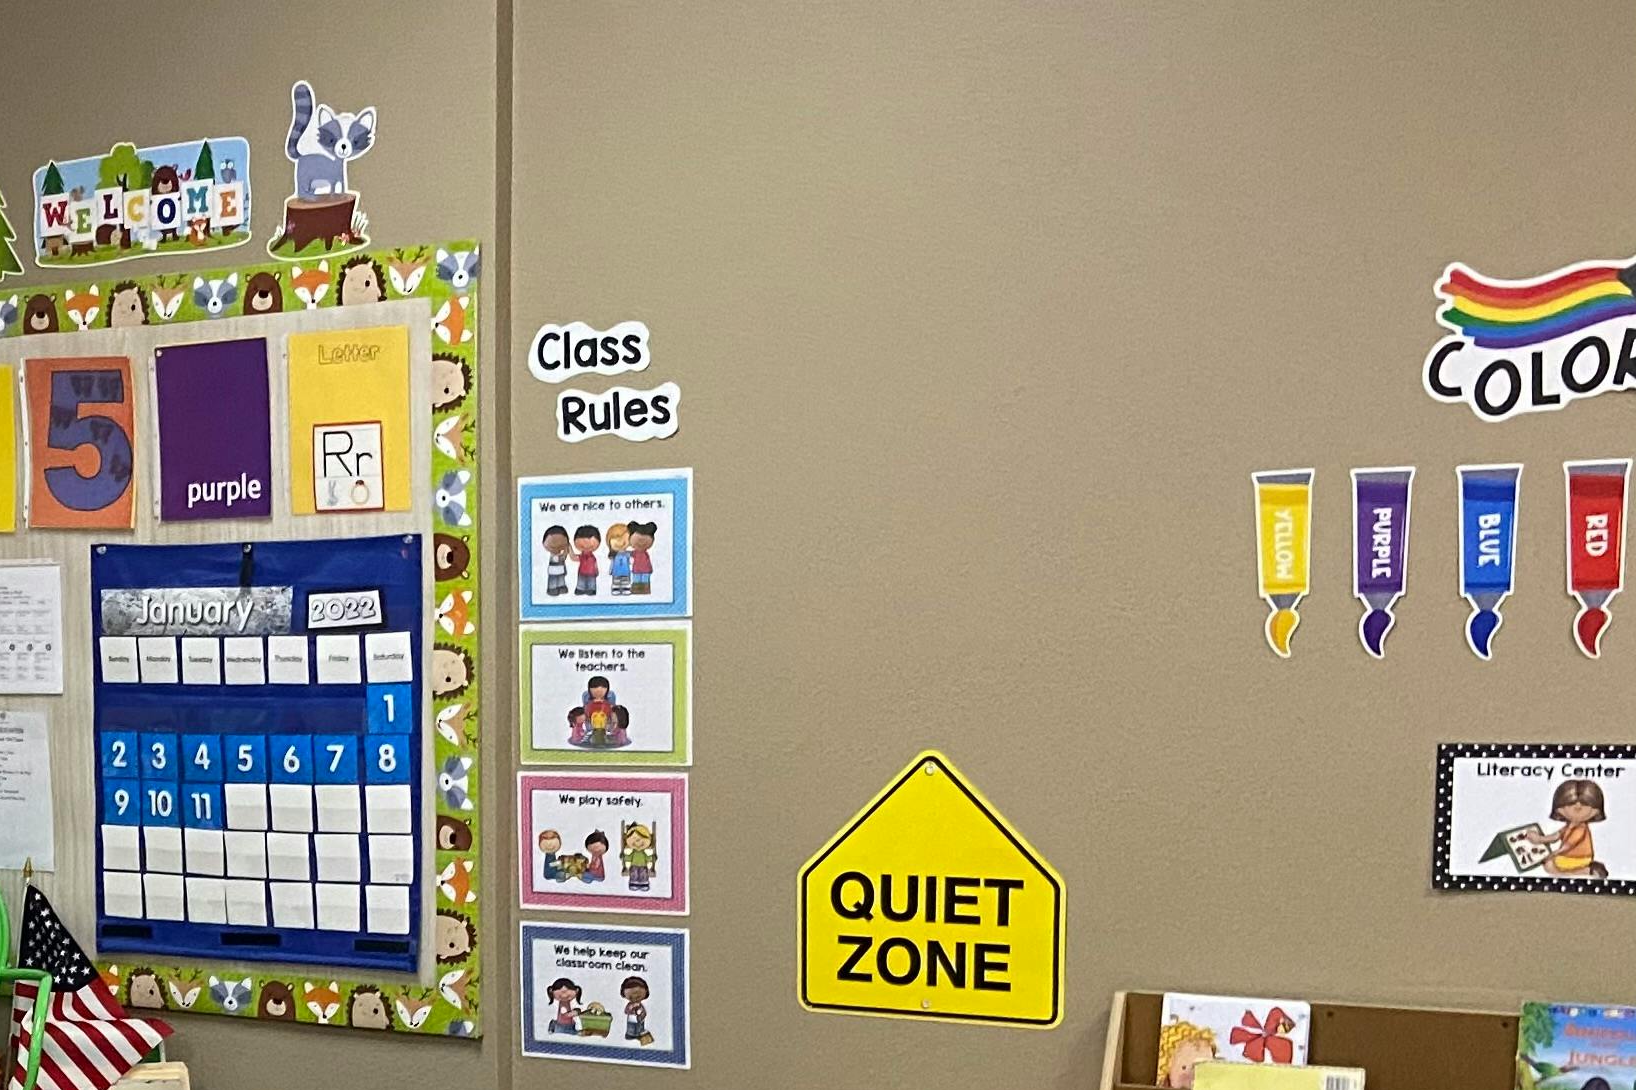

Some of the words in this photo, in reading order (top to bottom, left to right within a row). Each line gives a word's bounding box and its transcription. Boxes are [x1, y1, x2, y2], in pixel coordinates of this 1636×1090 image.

[43, 185, 237, 234] WELCOME
[318, 343, 380, 366] Letter
[537, 331, 642, 370] Class
[561, 391, 670, 435] Rules
[44, 370, 133, 511] 5
[323, 430, 373, 478] Rr
[188, 473, 261, 508] purple
[539, 501, 557, 513] We
[563, 502, 580, 512] are
[582, 500, 606, 511] nice
[610, 500, 621, 510] to
[625, 499, 665, 510] others.
[1274, 509, 1295, 581] YELLOW
[1371, 507, 1393, 579] PURPLE
[1478, 513, 1501, 567] BLUE
[1585, 513, 1609, 557] RED
[136, 595, 253, 632] January
[311, 598, 376, 622] 2022
[558, 648, 575, 660] We
[578, 648, 608, 660] listen
[612, 649, 624, 659] to
[627, 648, 645, 659] the
[576, 661, 628, 672] teachers.
[383, 694, 394, 723] 1
[112, 741, 127, 768] 2
[152, 742, 166, 770] 3
[194, 743, 211, 770] 4
[238, 745, 253, 772] 5
[283, 745, 300, 773] 6
[327, 745, 344, 773] 7
[378, 743, 396, 772] 8
[1477, 762, 1554, 780] Literacy
[1561, 763, 1626, 777] Center
[114, 789, 130, 816] 9
[147, 789, 172, 817] 10
[191, 793, 212, 820] 11
[559, 794, 576, 805] We
[579, 794, 602, 807] play
[606, 795, 643, 808] safely.
[830, 871, 1024, 927] QUIET
[554, 944, 570, 955] We
[573, 945, 596, 958] help
[599, 946, 627, 960] keep
[630, 950, 649, 960] our
[556, 958, 612, 970] classroom
[615, 960, 647, 972] clean.
[836, 935, 1011, 992] ZONE
